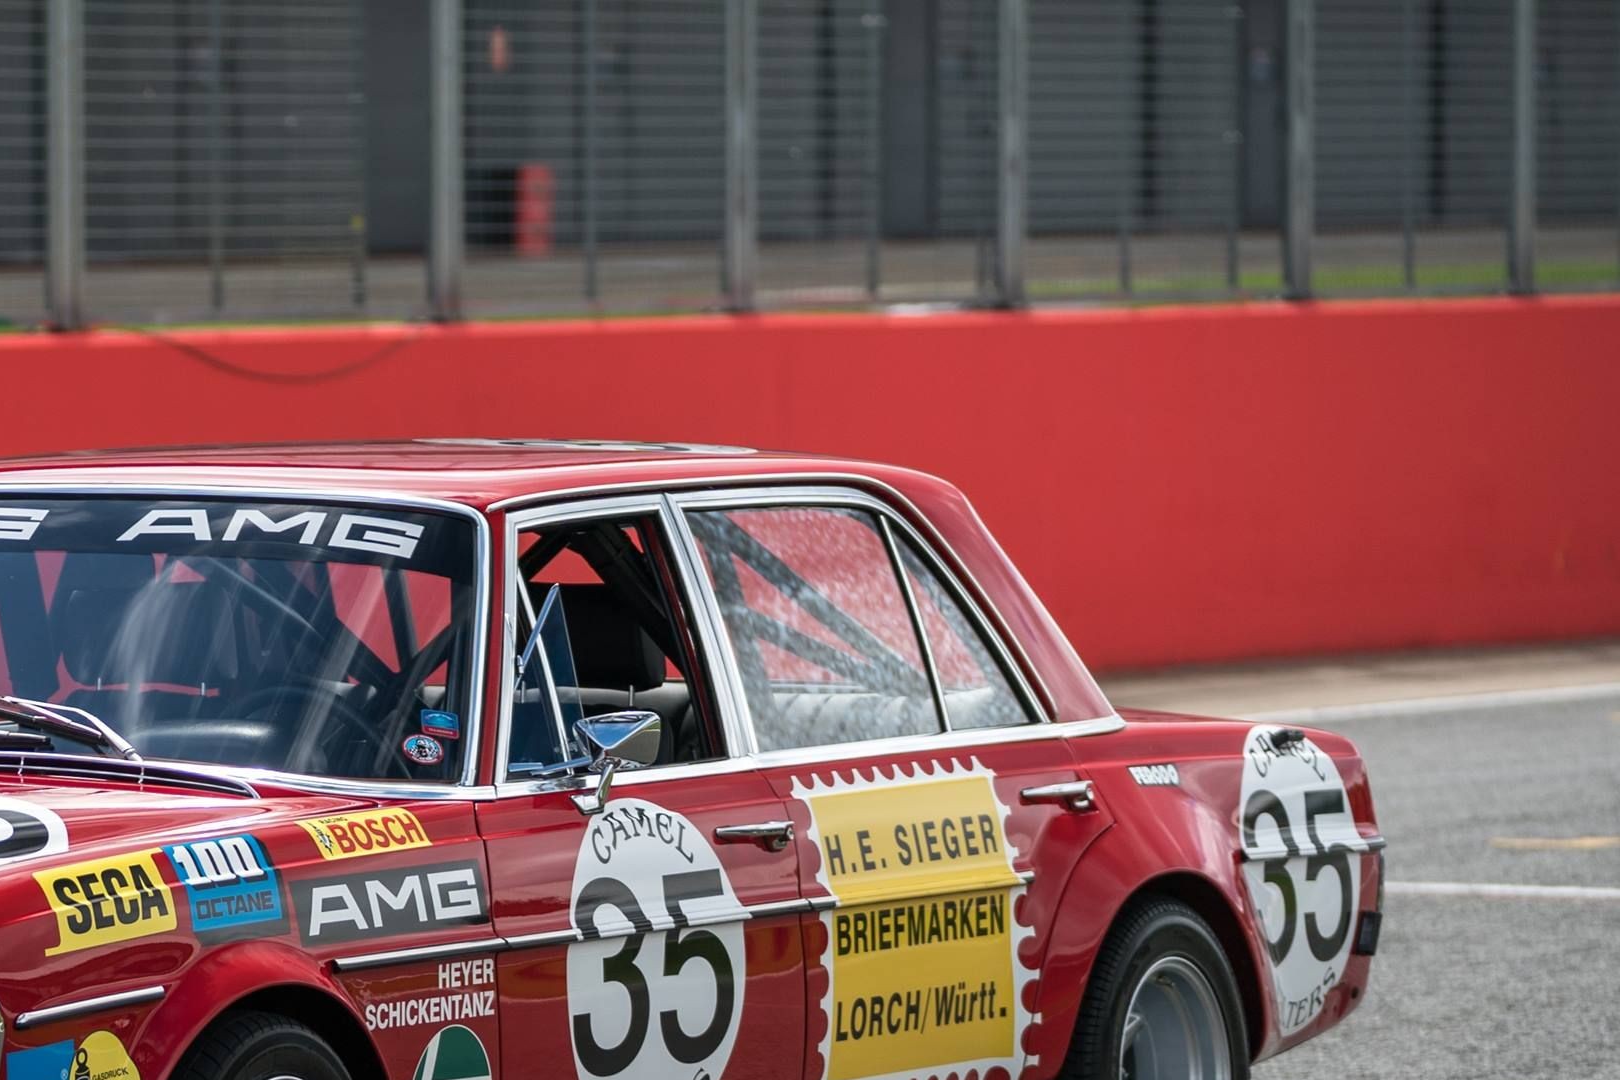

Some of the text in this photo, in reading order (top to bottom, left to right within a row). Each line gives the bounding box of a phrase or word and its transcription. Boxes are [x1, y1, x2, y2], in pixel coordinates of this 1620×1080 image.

[116, 508, 425, 560] AMG
[173, 837, 266, 888] 100
[326, 813, 424, 853] BOSCH
[591, 807, 695, 864] CAMEL
[824, 813, 998, 876] H.E. SIEGER
[52, 864, 169, 935] SECA
[196, 890, 274, 920] OCTANE
[309, 868, 481, 936] AMG
[1243, 788, 1353, 968] 35
[836, 893, 1005, 956] BRIEFMARKEN
[438, 958, 495, 990] HEYER
[572, 868, 735, 1078] 35
[364, 990, 495, 1032] SCHICKENTANZ
[835, 980, 1007, 1042] LORCH/Württ.
